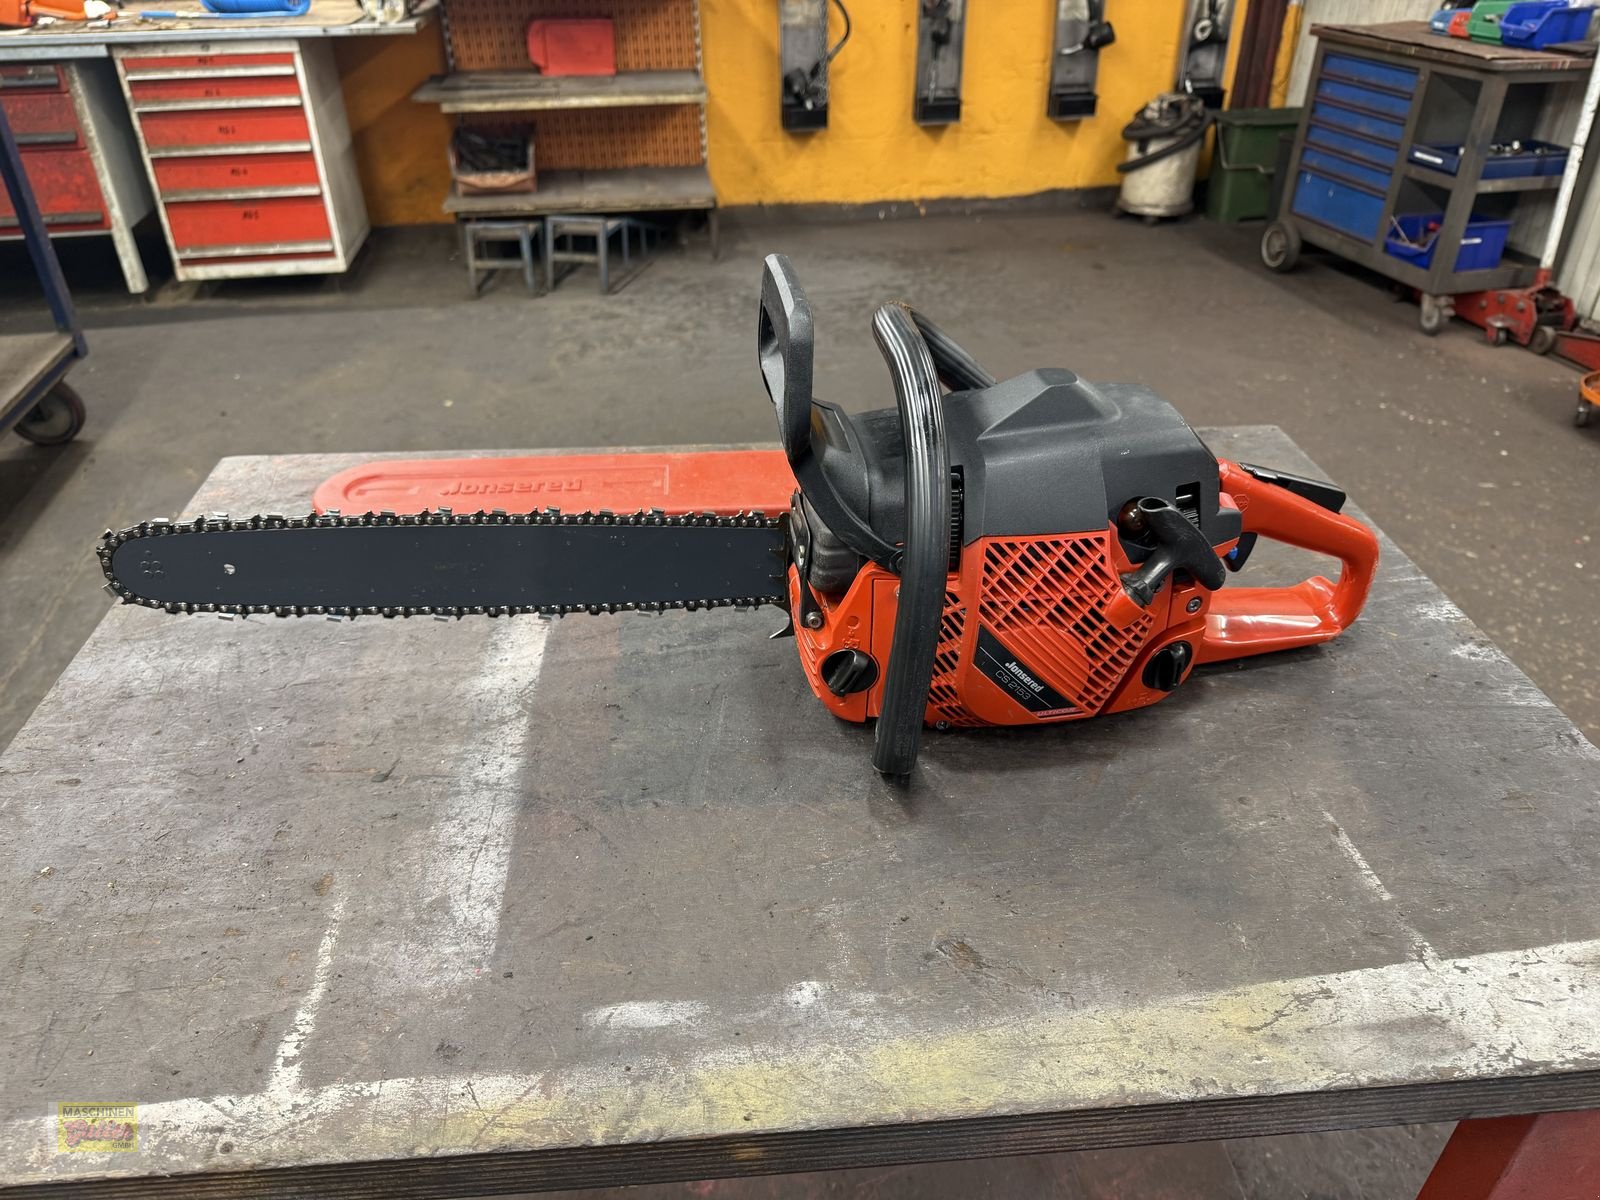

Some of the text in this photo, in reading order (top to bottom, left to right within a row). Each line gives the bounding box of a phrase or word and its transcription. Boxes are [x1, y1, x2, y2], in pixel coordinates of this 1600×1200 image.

[440, 479, 582, 496] Jonsered
[995, 670, 1031, 700] CS 2153
[1005, 661, 1044, 692] Jonsered
